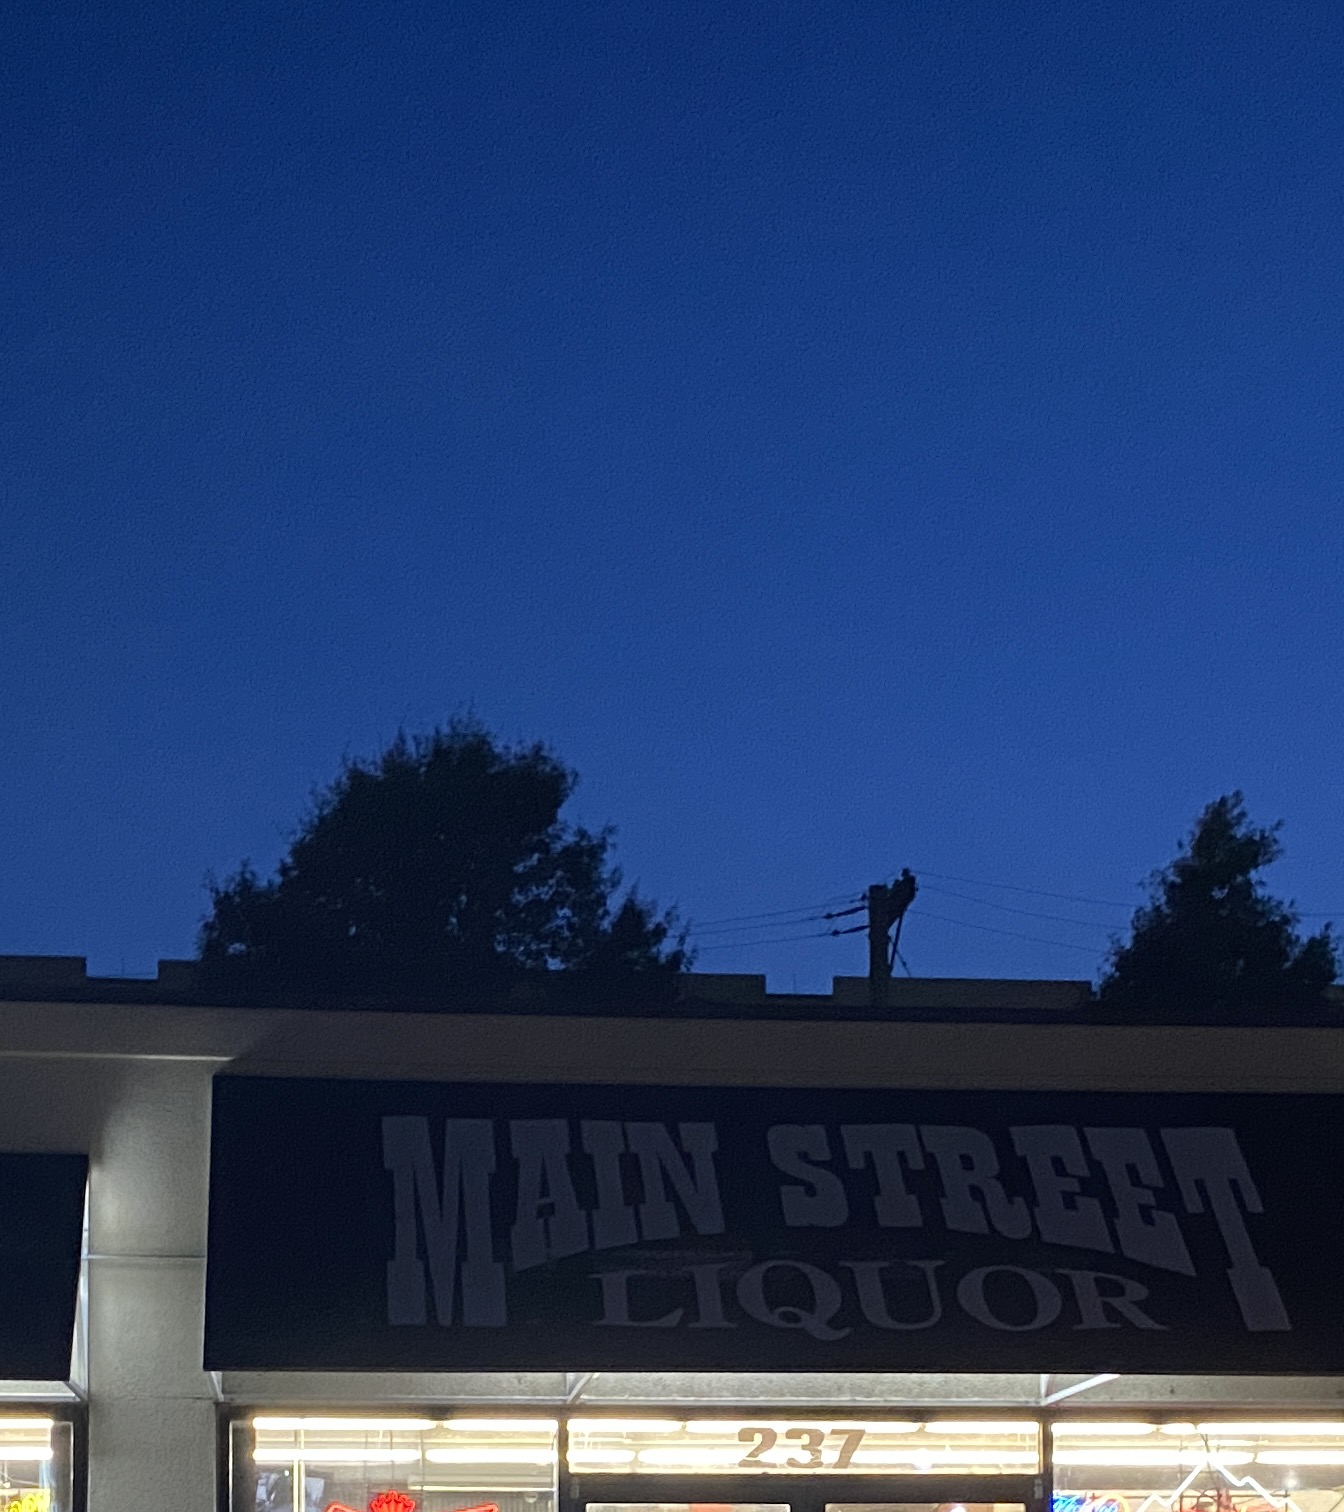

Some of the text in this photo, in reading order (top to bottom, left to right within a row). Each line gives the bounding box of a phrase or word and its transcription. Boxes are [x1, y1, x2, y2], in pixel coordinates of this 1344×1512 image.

[381, 1115, 1292, 1332] MAIN STREET
[588, 1259, 1171, 1342] LIQUOR
[737, 1428, 866, 1470] 237
